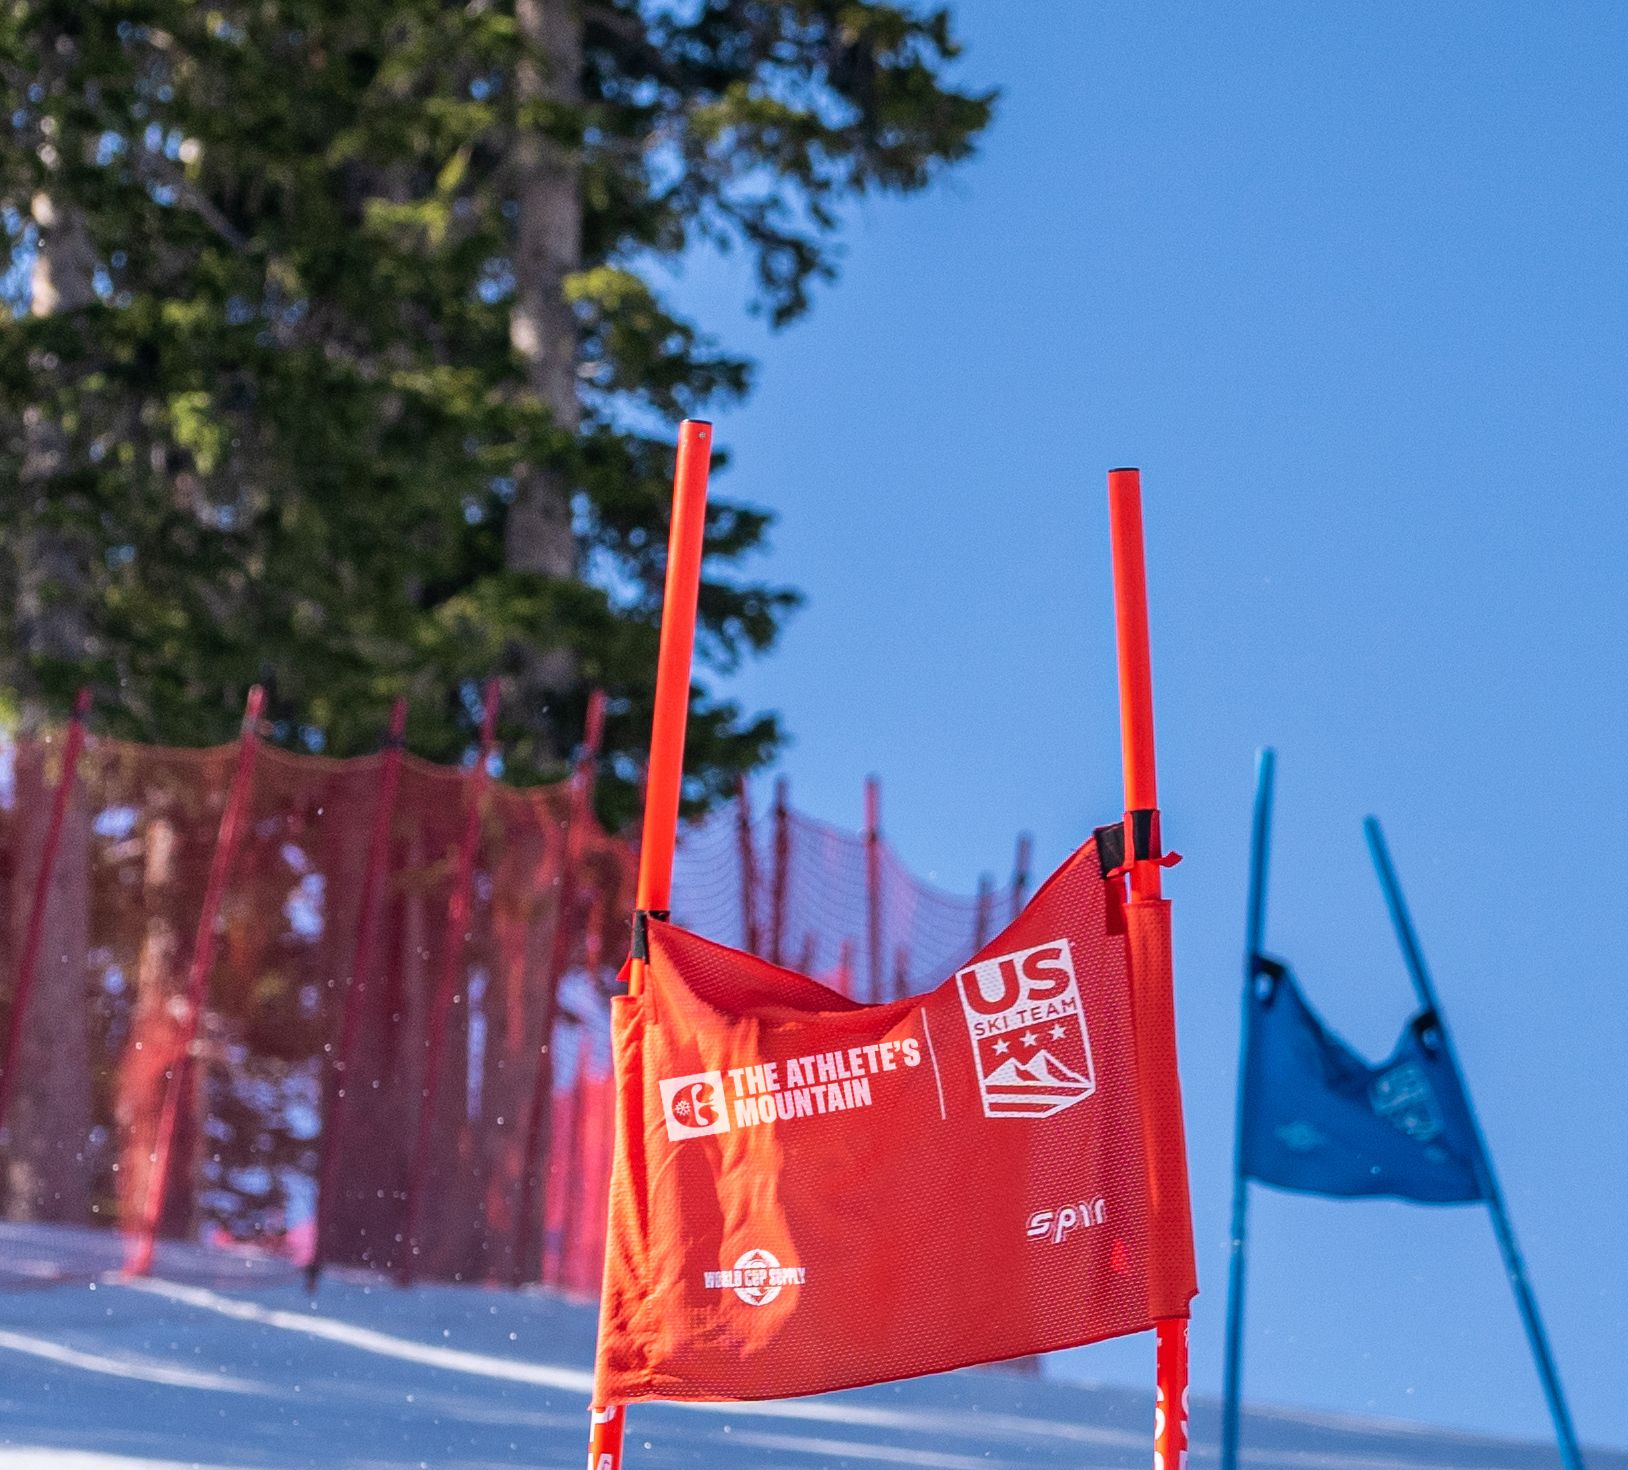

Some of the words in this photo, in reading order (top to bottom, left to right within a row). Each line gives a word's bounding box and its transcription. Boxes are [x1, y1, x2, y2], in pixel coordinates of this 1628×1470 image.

[961, 947, 1071, 1015] US
[974, 1015, 1009, 1037] SKI
[1016, 997, 1078, 1024] TEAM
[728, 1062, 780, 1098] THE
[786, 1038, 921, 1089] ATHLETE'S
[734, 1077, 873, 1129] MOUNTAIN
